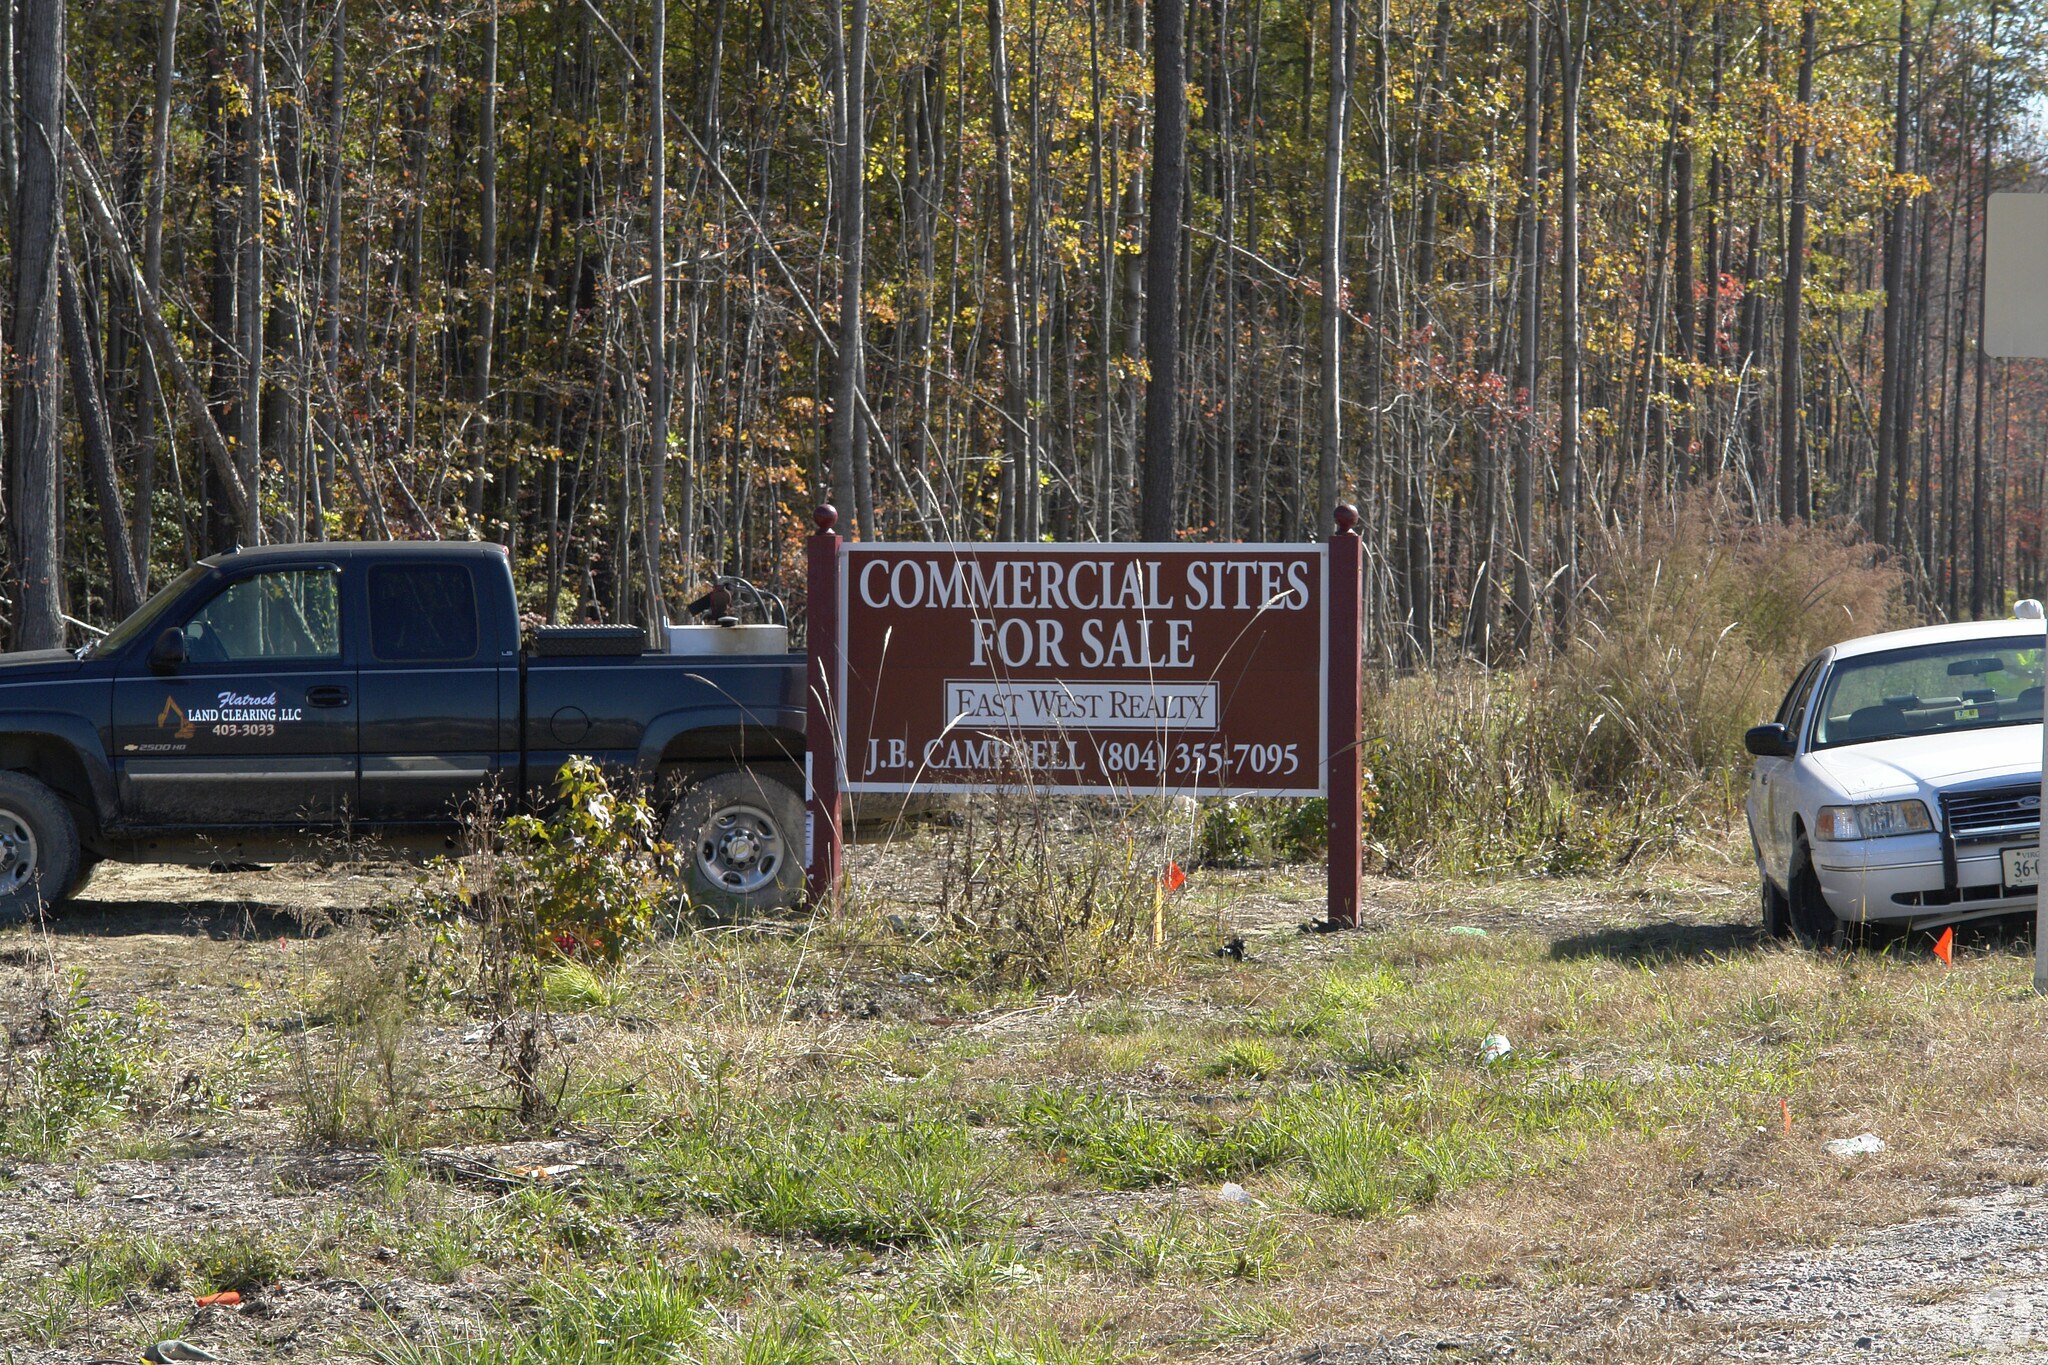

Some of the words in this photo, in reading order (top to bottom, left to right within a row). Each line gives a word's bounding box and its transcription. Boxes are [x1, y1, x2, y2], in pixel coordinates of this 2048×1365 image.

[859, 559, 1174, 610] COMMERCIAL
[1185, 560, 1309, 610] SITES
[969, 618, 1070, 667] FOR
[1080, 618, 1195, 668] SALE
[217, 691, 277, 708] Flatrock
[956, 689, 1024, 718] EAST
[1027, 689, 1103, 718] WEST
[1109, 690, 1209, 719] REALTY
[188, 709, 219, 721] LAND
[221, 708, 277, 721] CLEARING
[212, 723, 275, 737] 403-3033
[865, 738, 914, 775] J.B.
[1099, 739, 1165, 777] (804)
[1174, 742, 1300, 776] 355-7095
[2021, 850, 2040, 859] VIRG
